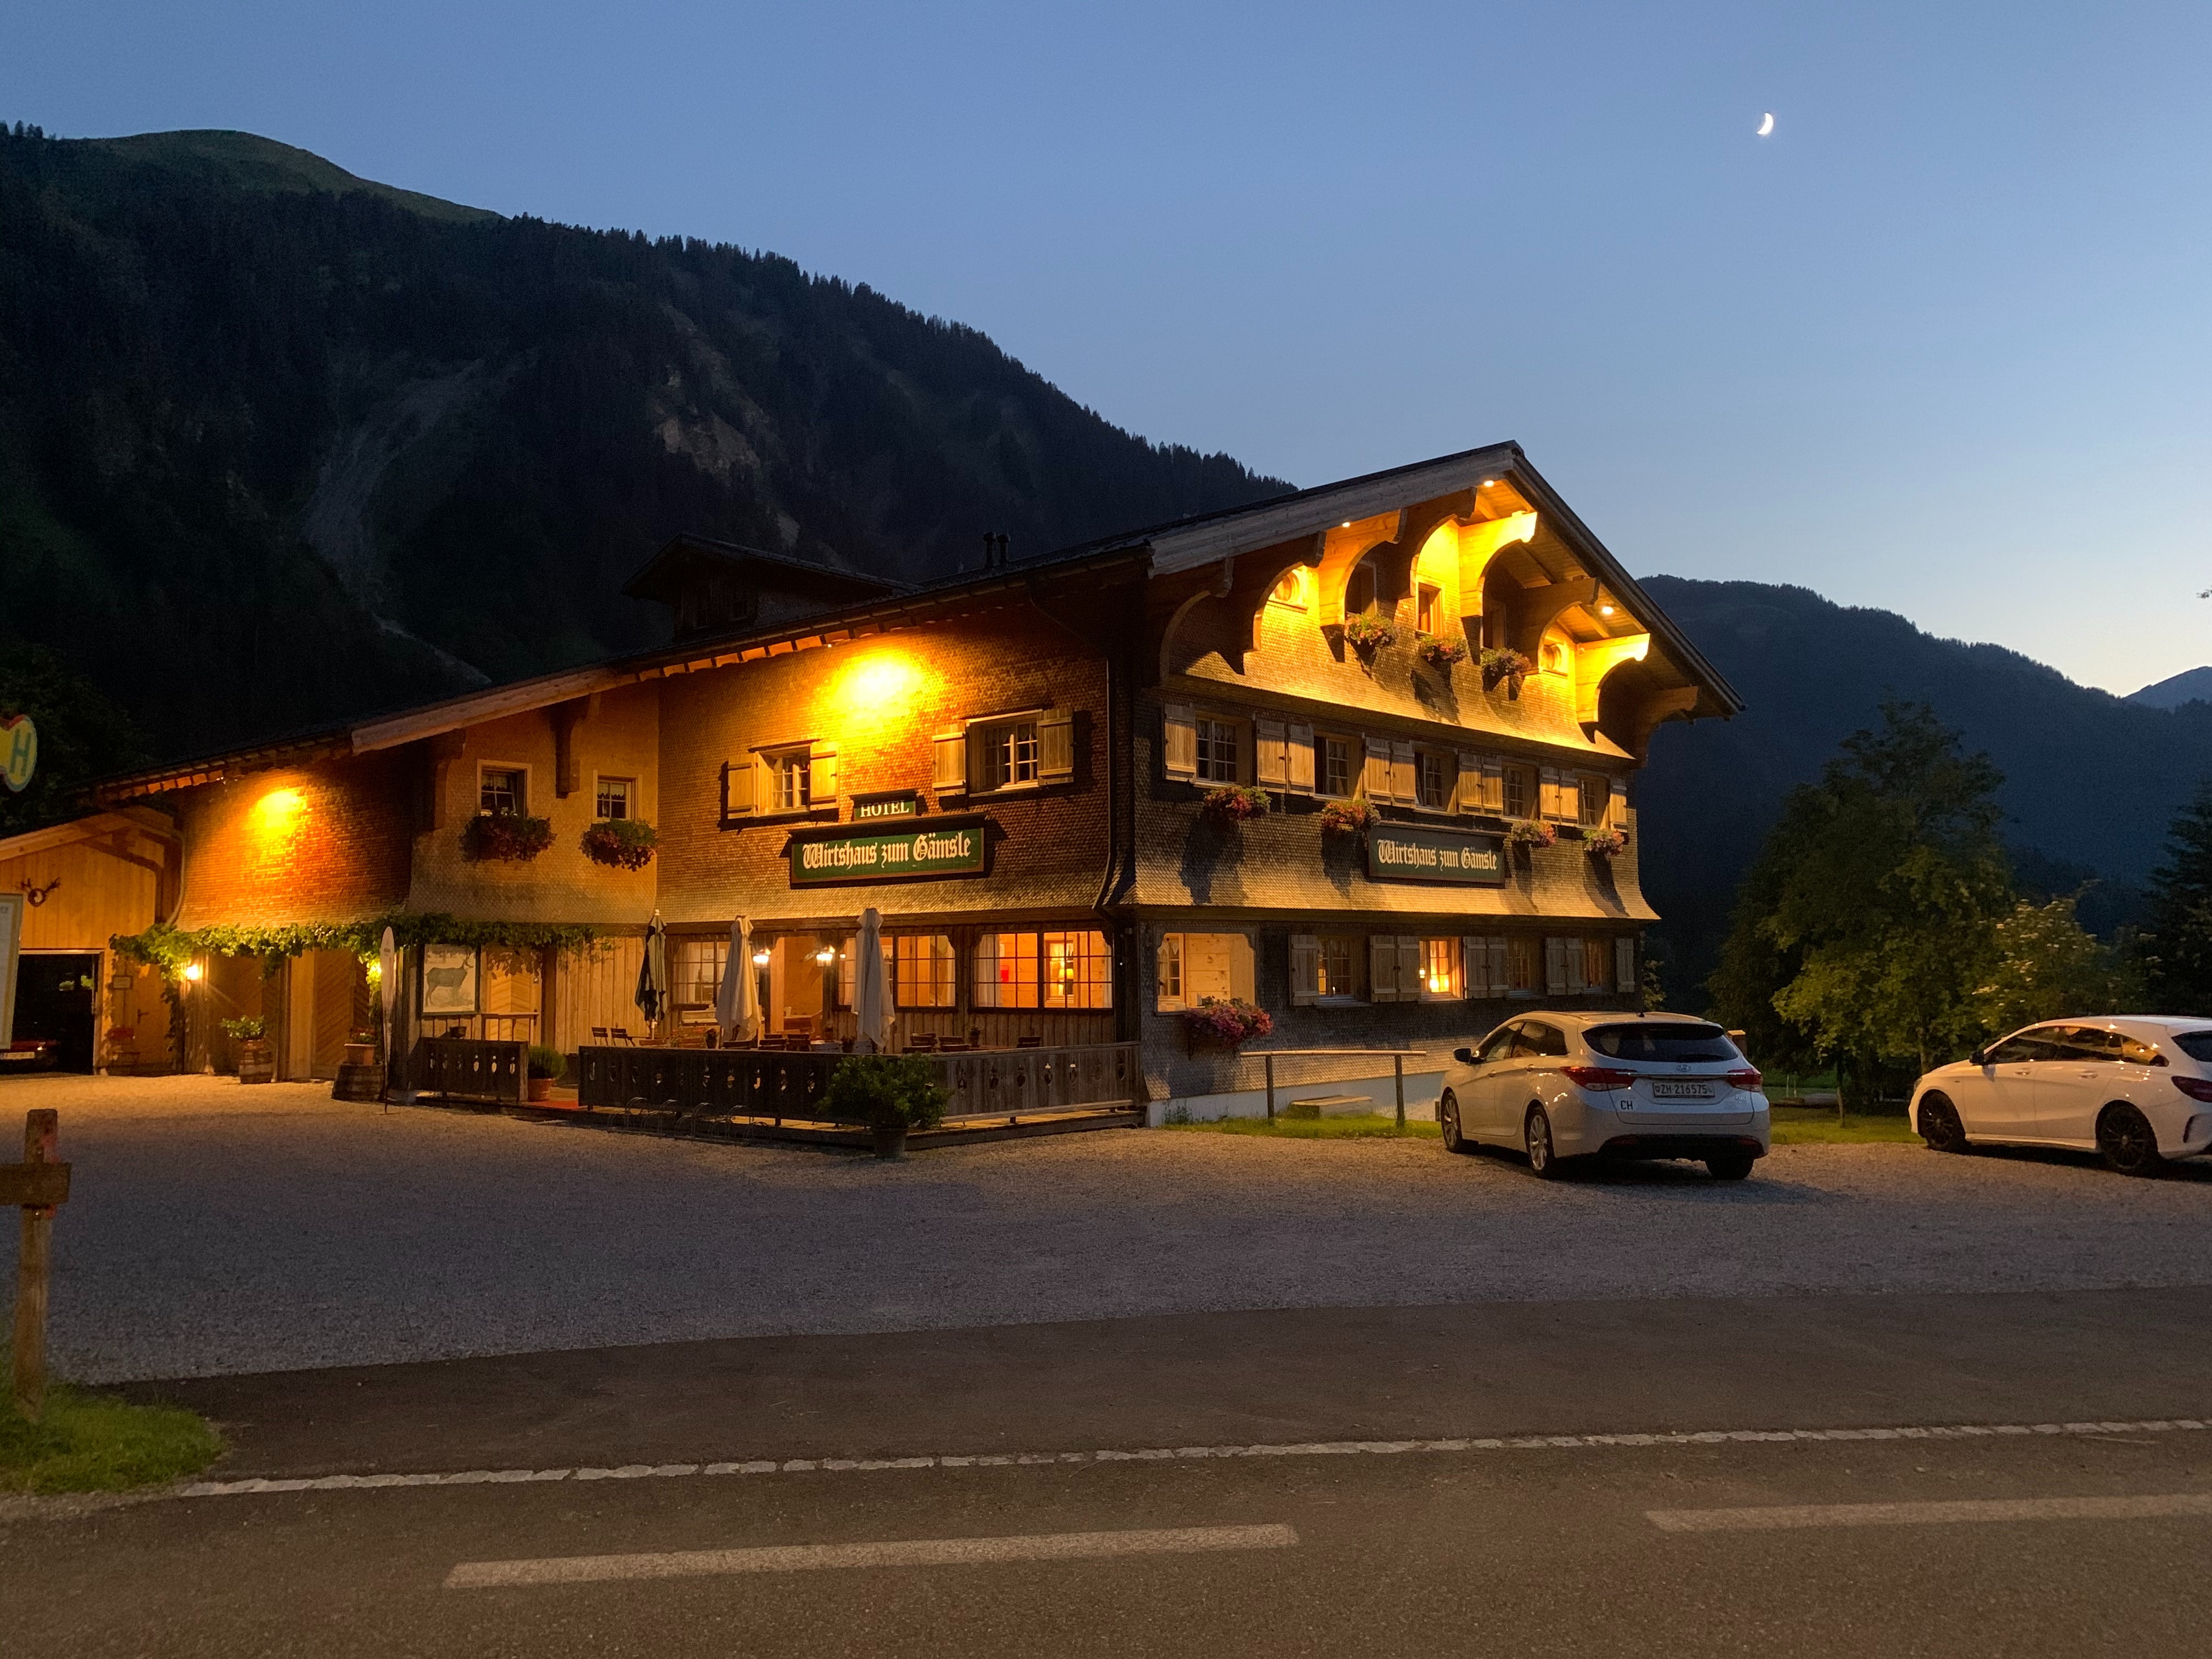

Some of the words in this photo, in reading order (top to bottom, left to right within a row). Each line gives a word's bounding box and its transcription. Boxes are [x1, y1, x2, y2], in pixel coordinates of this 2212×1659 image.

[860, 800, 909, 817] HOTEL
[802, 841, 878, 870] Wirtshaus
[881, 843, 909, 868] zum
[913, 831, 971, 861] Gämsle
[1377, 838, 1436, 869] Wirtshaus
[1438, 850, 1459, 872] zum
[1460, 845, 1497, 871] Gämsle
[1620, 1101, 1633, 1110] CH
